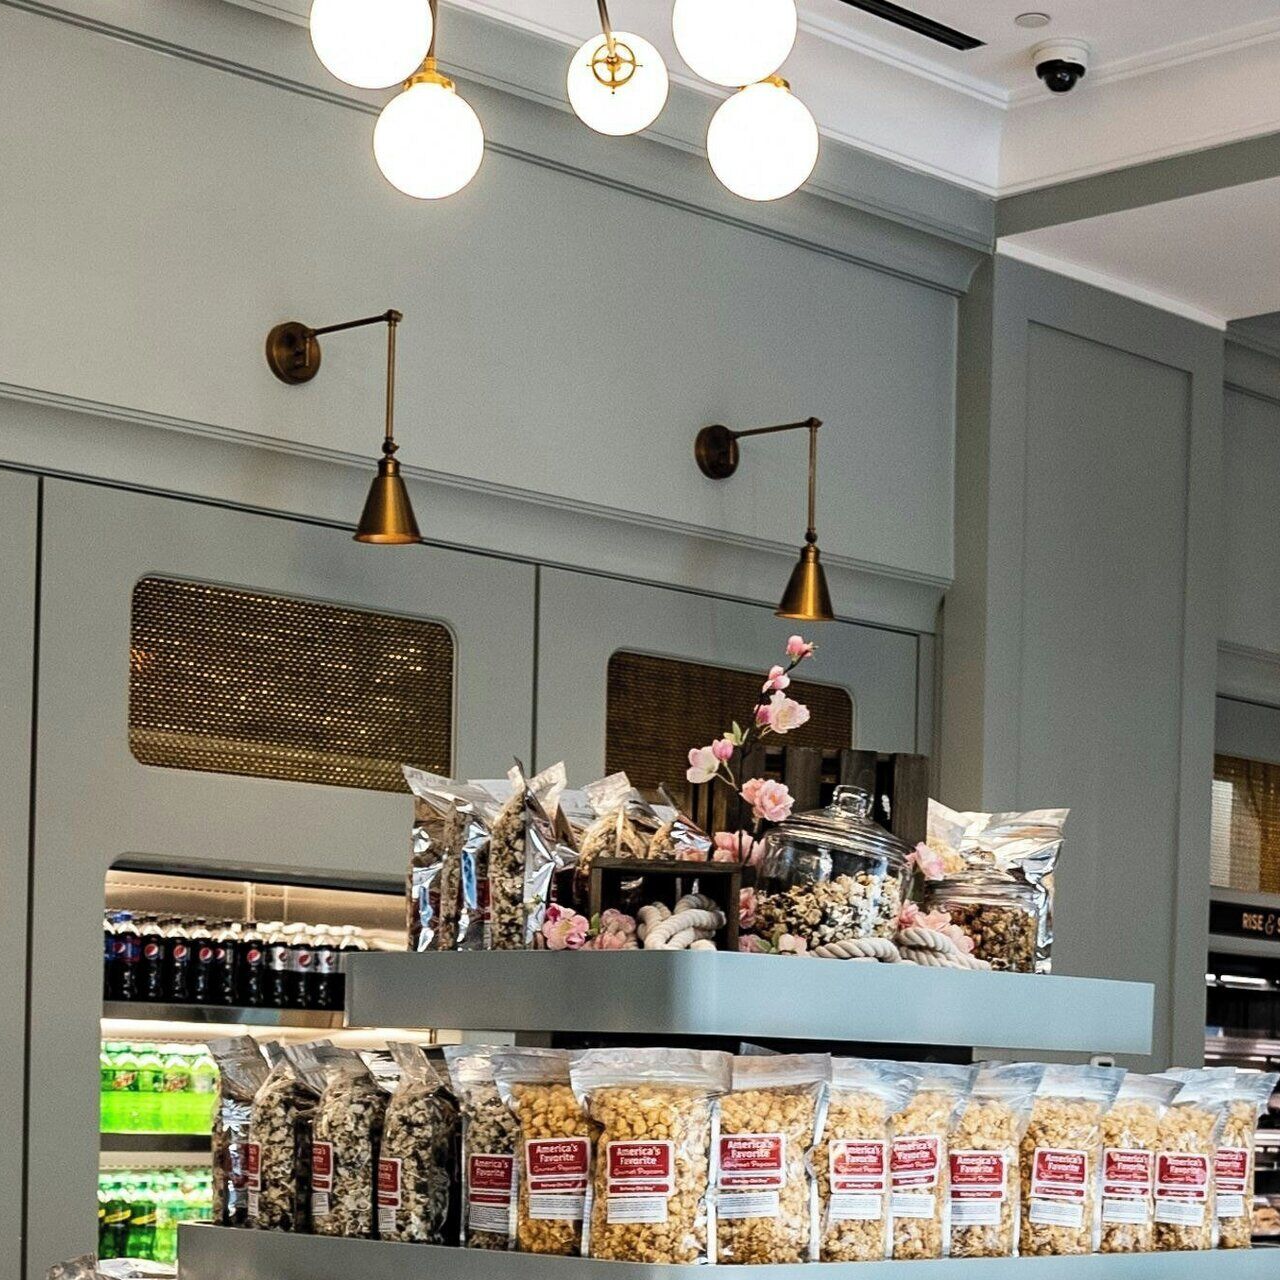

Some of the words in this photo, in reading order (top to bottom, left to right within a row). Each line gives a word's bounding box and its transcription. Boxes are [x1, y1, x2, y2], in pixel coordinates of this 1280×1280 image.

[1242, 912, 1264, 930] RISE
[1265, 913, 1275, 935] &
[536, 1144, 578, 1154] America's
[727, 1140, 774, 1150] America's
[617, 1146, 660, 1156] America's
[731, 1149, 769, 1159] Favorite
[474, 1158, 508, 1168] America's
[540, 1154, 575, 1163] Favorite
[620, 1156, 656, 1165] Favorite
[957, 1156, 997, 1165] America's
[960, 1165, 994, 1173] Favorite
